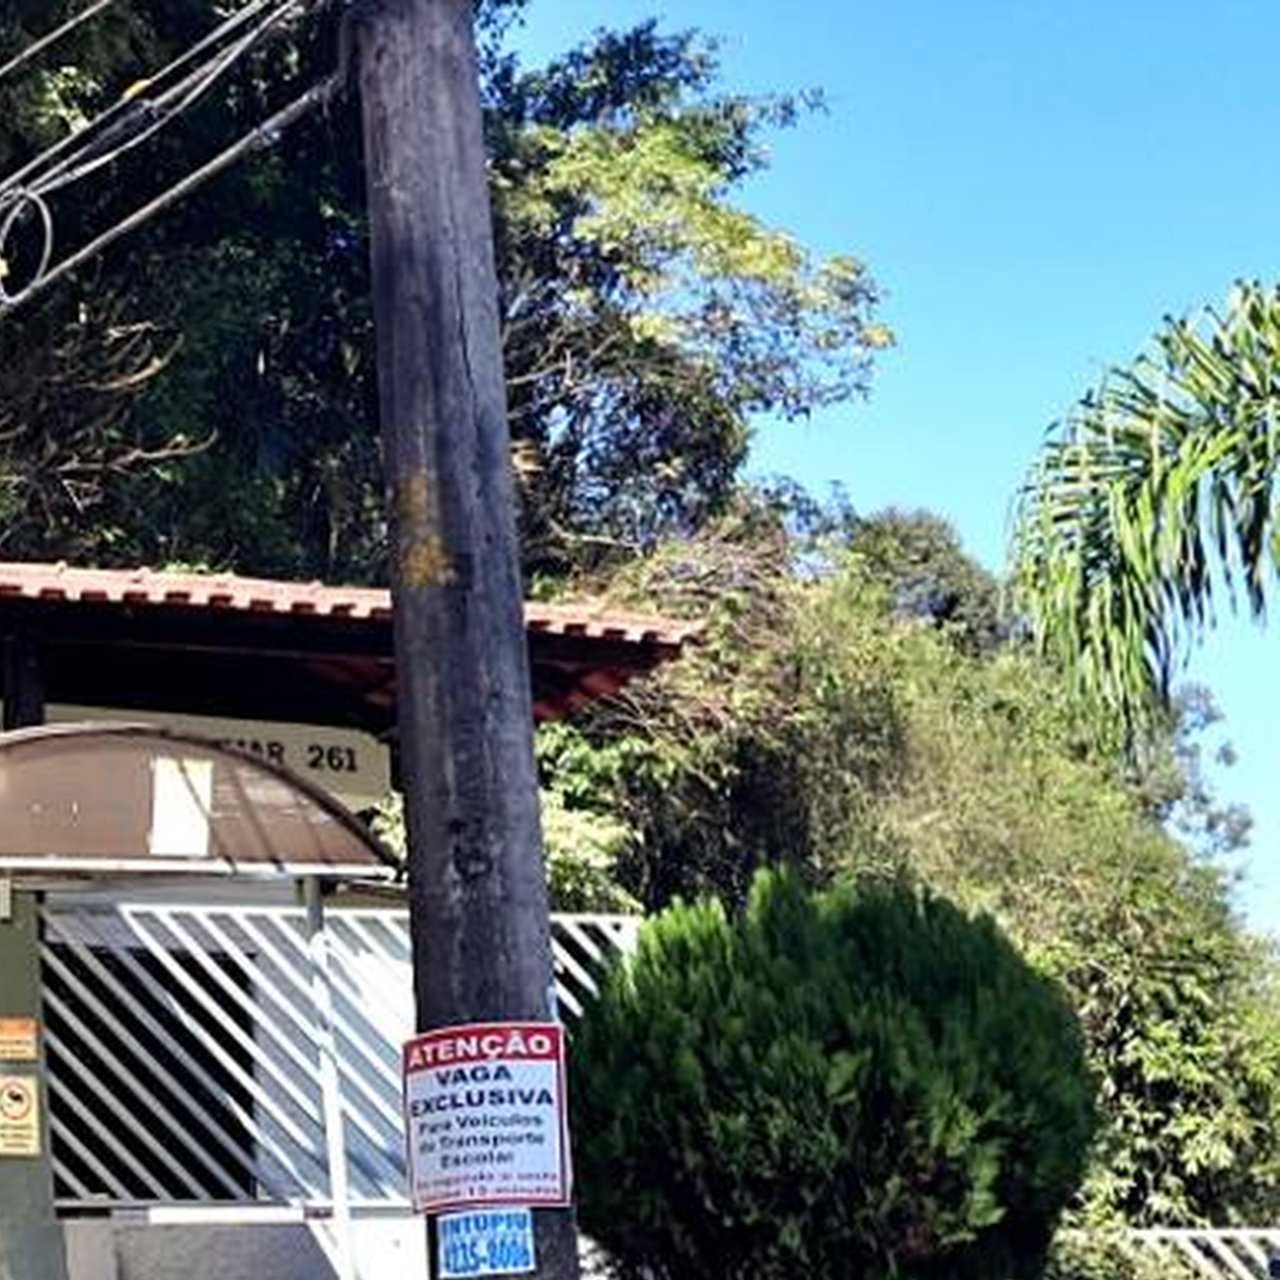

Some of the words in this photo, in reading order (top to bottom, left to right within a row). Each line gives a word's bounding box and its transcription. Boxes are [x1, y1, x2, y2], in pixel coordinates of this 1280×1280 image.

[306, 743, 358, 772] 261
[408, 1029, 552, 1068] ATENÇÃO
[435, 1065, 513, 1087] VAGA
[410, 1088, 555, 1117] EXCLUSIVA
